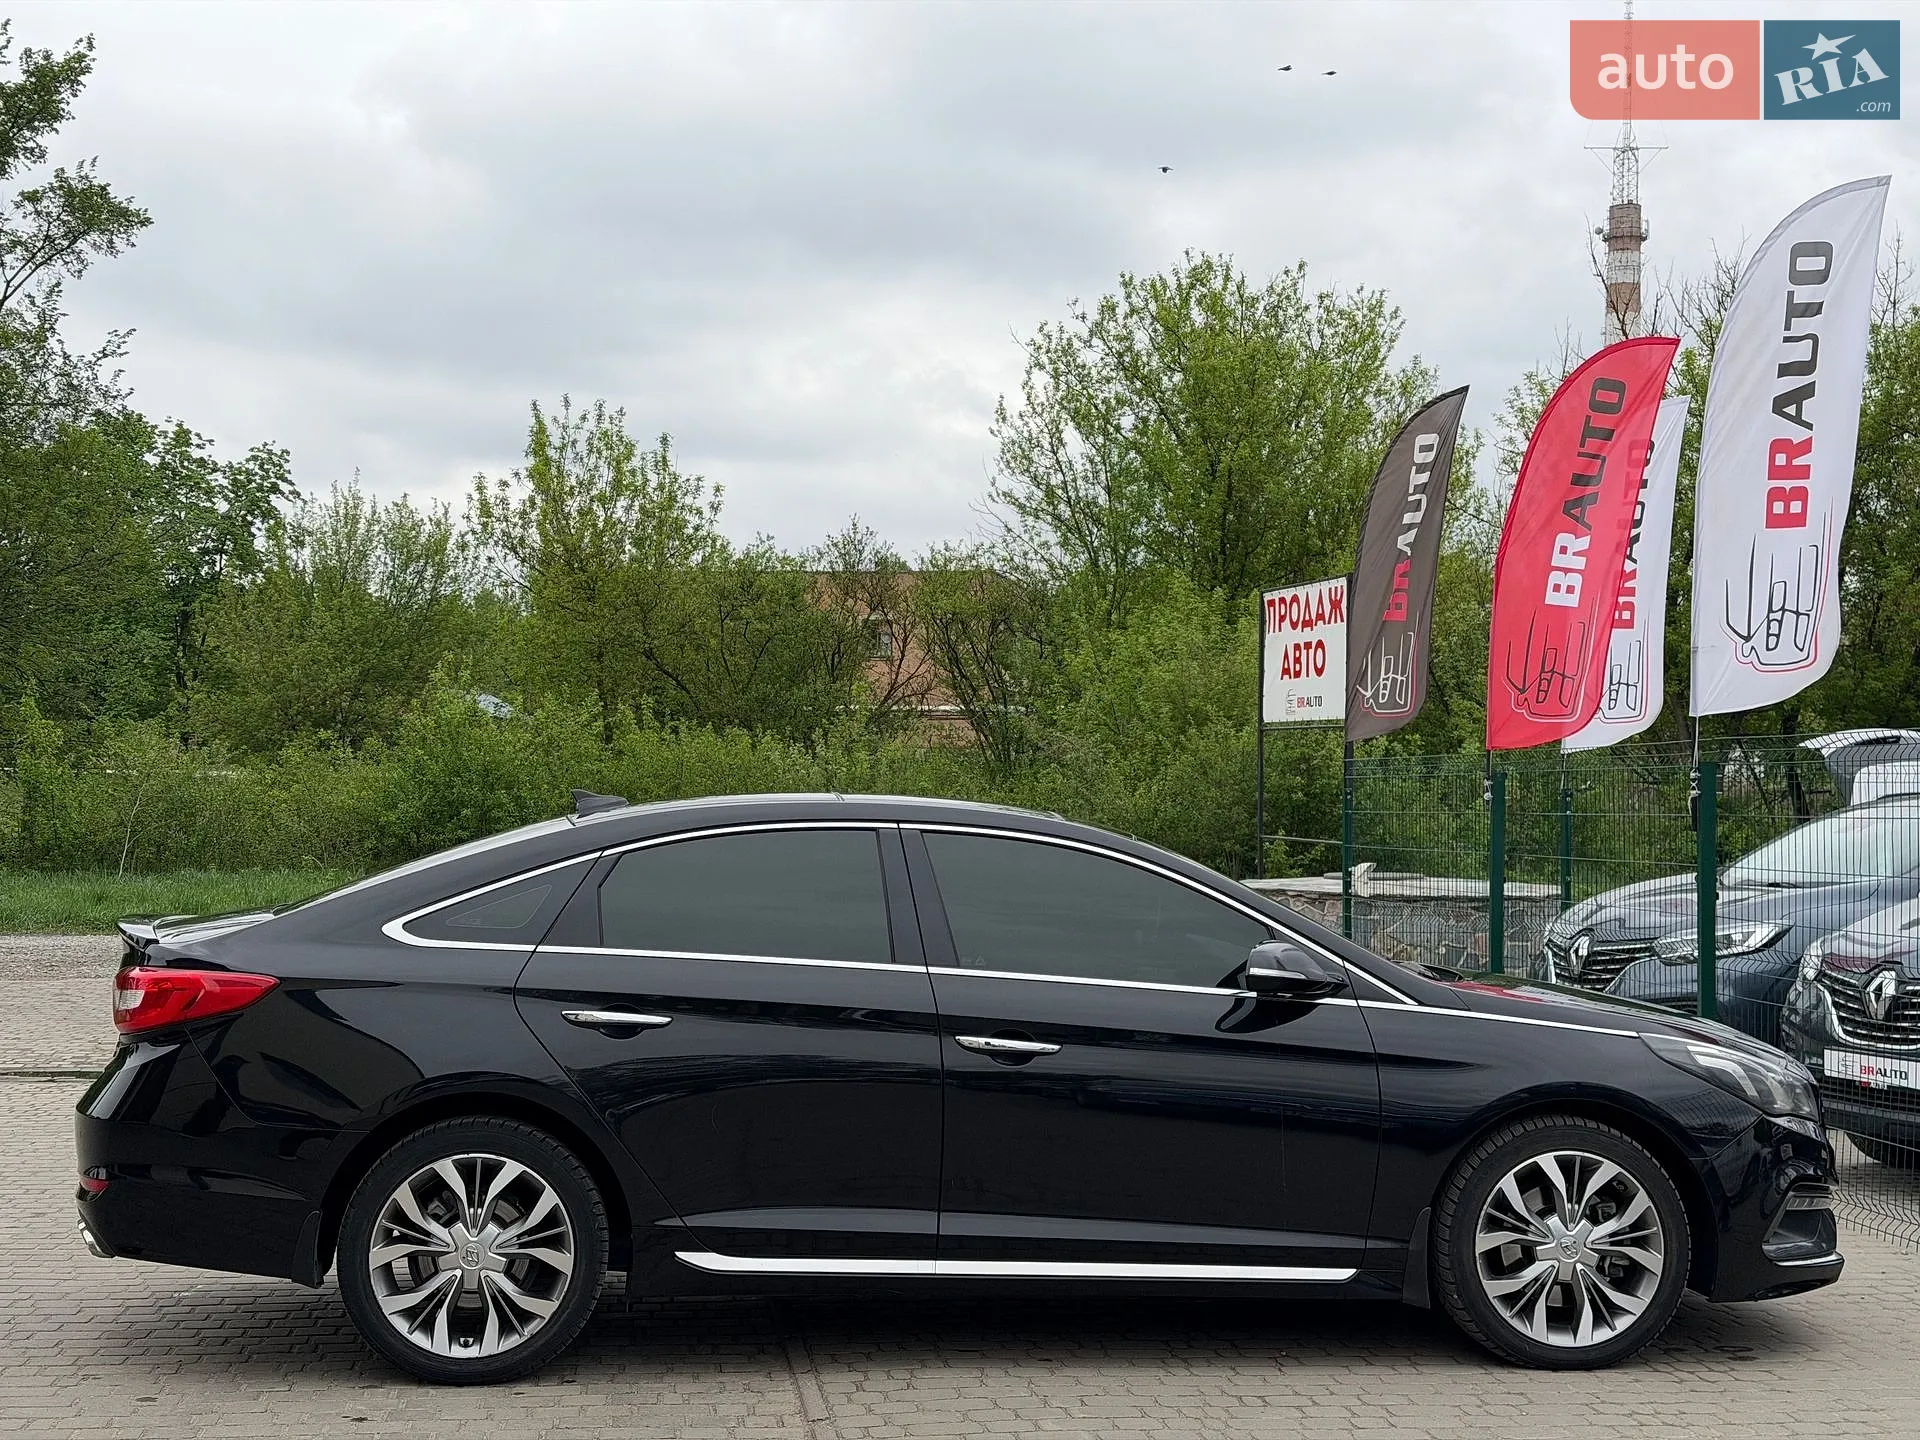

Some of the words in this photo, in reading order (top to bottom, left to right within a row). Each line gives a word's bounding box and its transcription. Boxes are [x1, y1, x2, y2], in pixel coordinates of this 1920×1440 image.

[1765, 241, 1833, 529] BRAUTO
[1544, 377, 1627, 608] BRAUTO
[1266, 585, 1345, 634] ПРОДАЖ
[1280, 639, 1327, 681] АВТО
